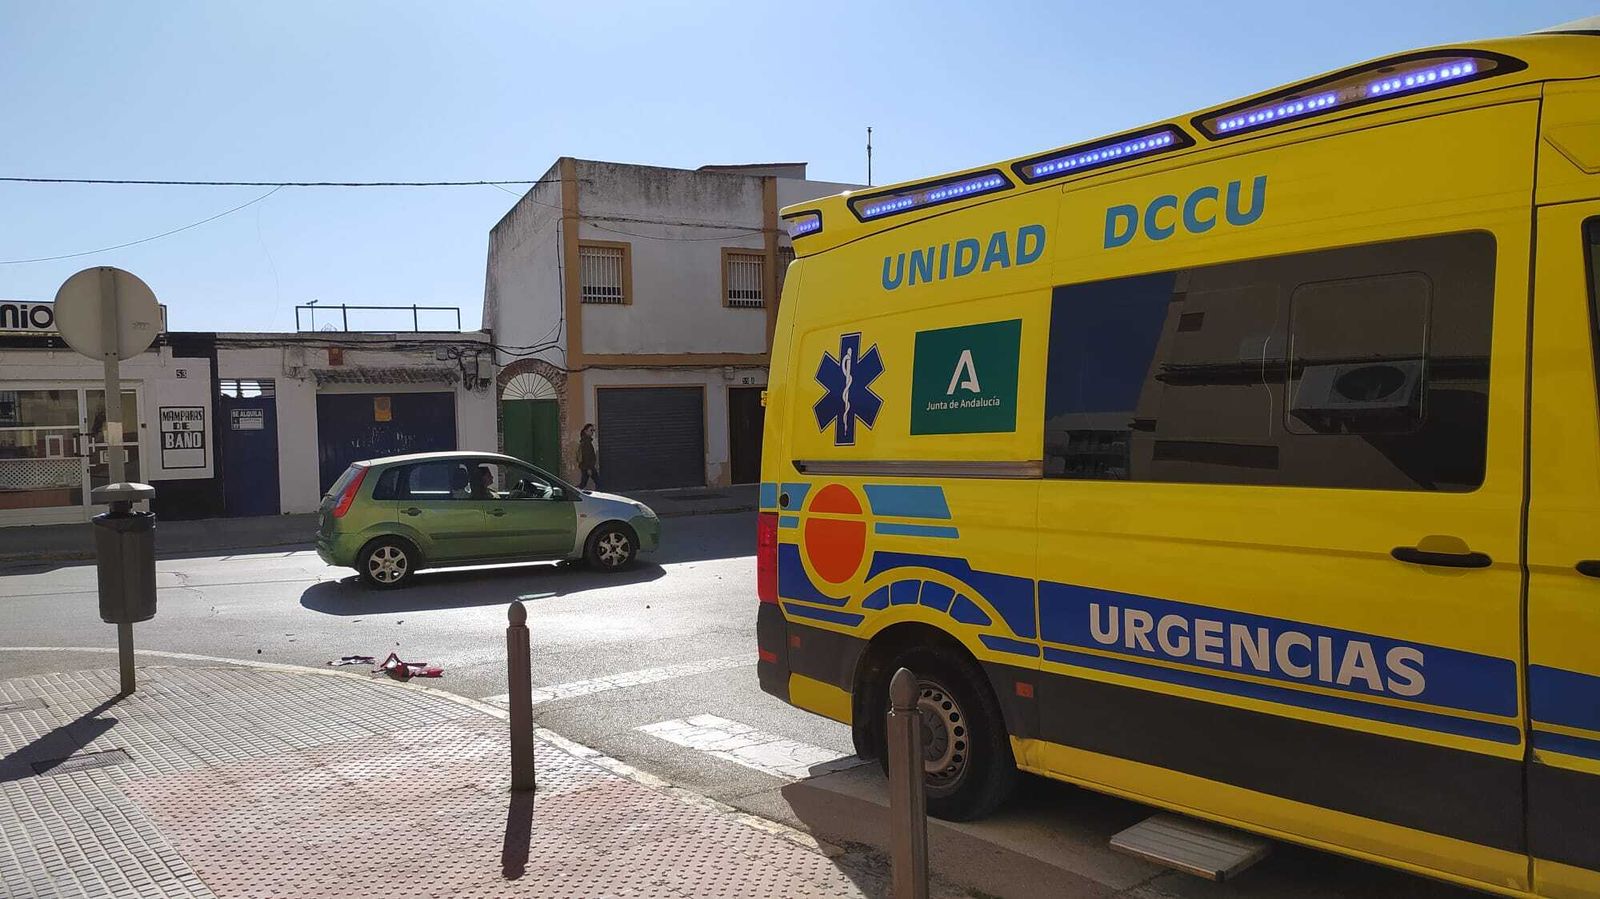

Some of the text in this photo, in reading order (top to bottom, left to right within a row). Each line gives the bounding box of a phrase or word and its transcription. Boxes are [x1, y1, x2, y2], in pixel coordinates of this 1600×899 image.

[881, 175, 1268, 291] UNIDAD DCCU
[926, 396, 1001, 411] Junta de Andalucía
[162, 410, 203, 421] MAMPARAS
[172, 422, 190, 430] DE
[1089, 602, 1426, 697] URGENCIAS
